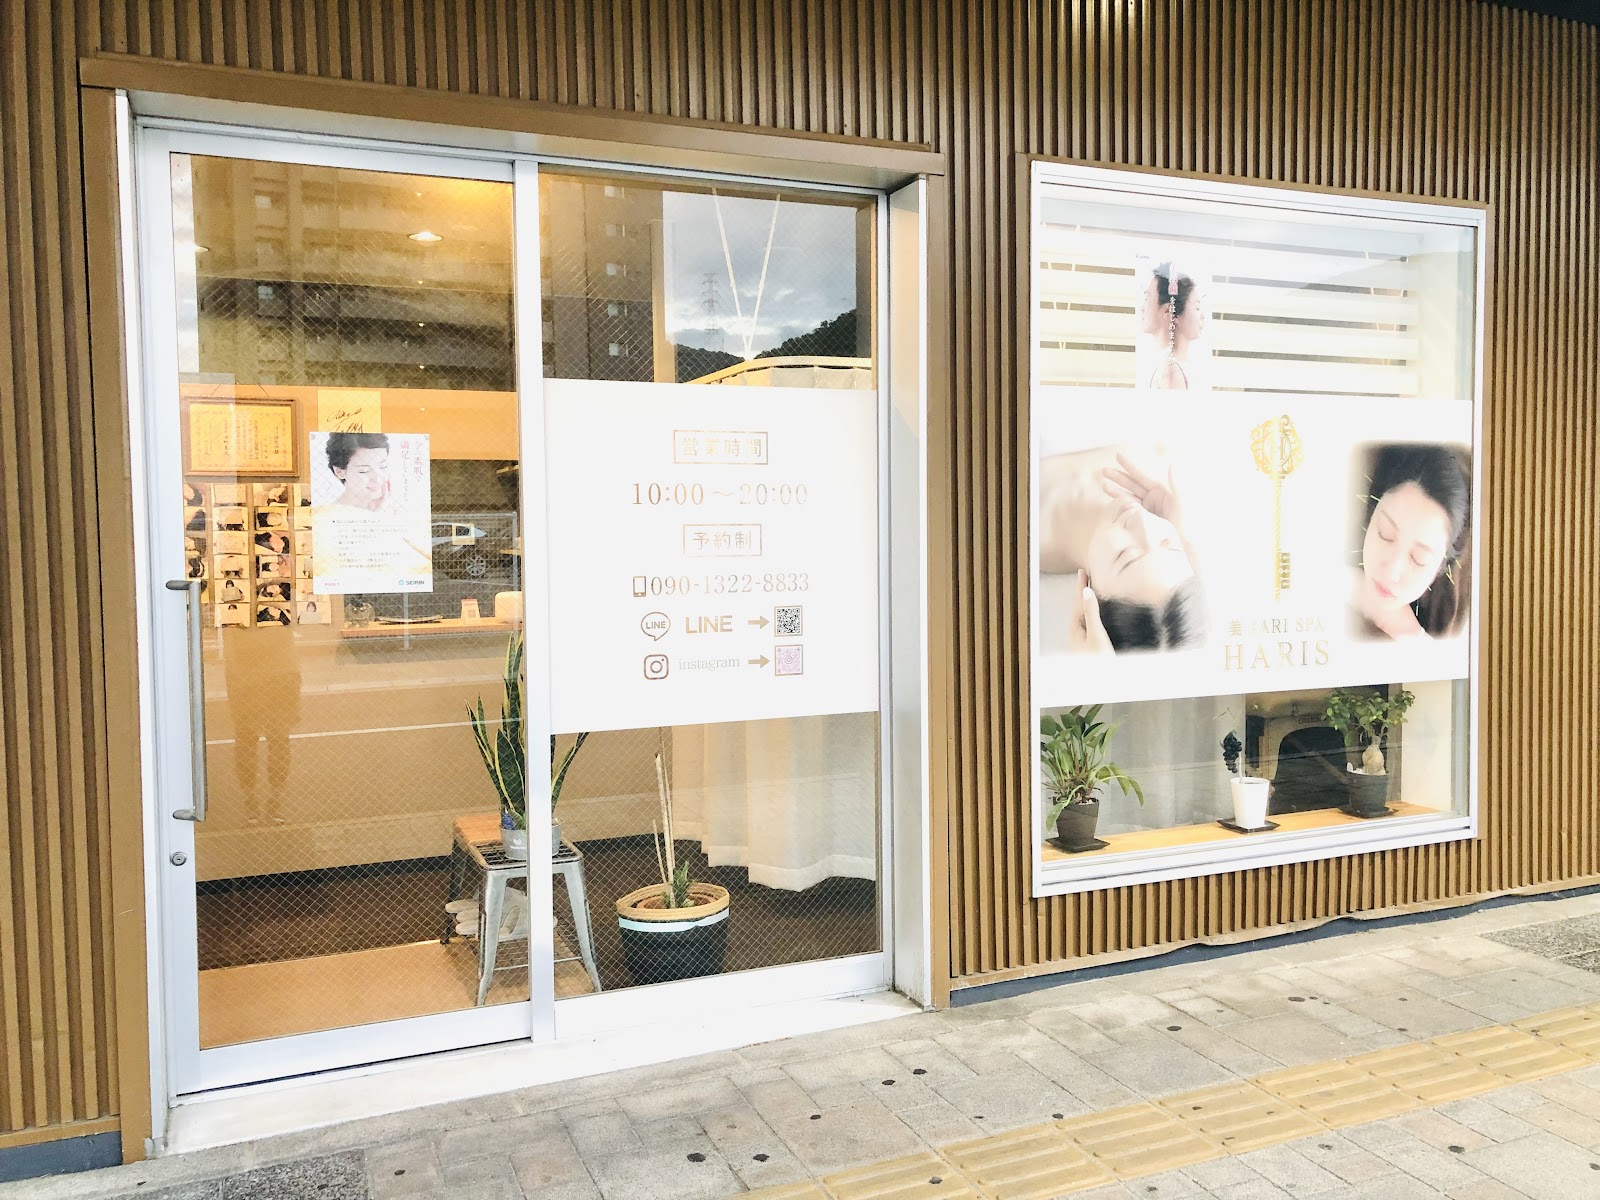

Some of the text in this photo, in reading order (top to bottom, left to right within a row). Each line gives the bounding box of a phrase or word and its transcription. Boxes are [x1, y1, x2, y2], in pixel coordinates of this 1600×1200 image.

[683, 437, 762, 457] 営業時間
[632, 482, 704, 505] 10:00
[739, 482, 808, 505] 20:00
[692, 531, 752, 550] 予約制
[651, 572, 809, 596] 090-1322-8833
[645, 621, 666, 629] LINE
[685, 615, 733, 634] LINE
[1228, 618, 1243, 637] 美
[1295, 616, 1326, 633] SPA
[678, 657, 740, 672] instagram
[1223, 639, 1329, 671] HARIS
